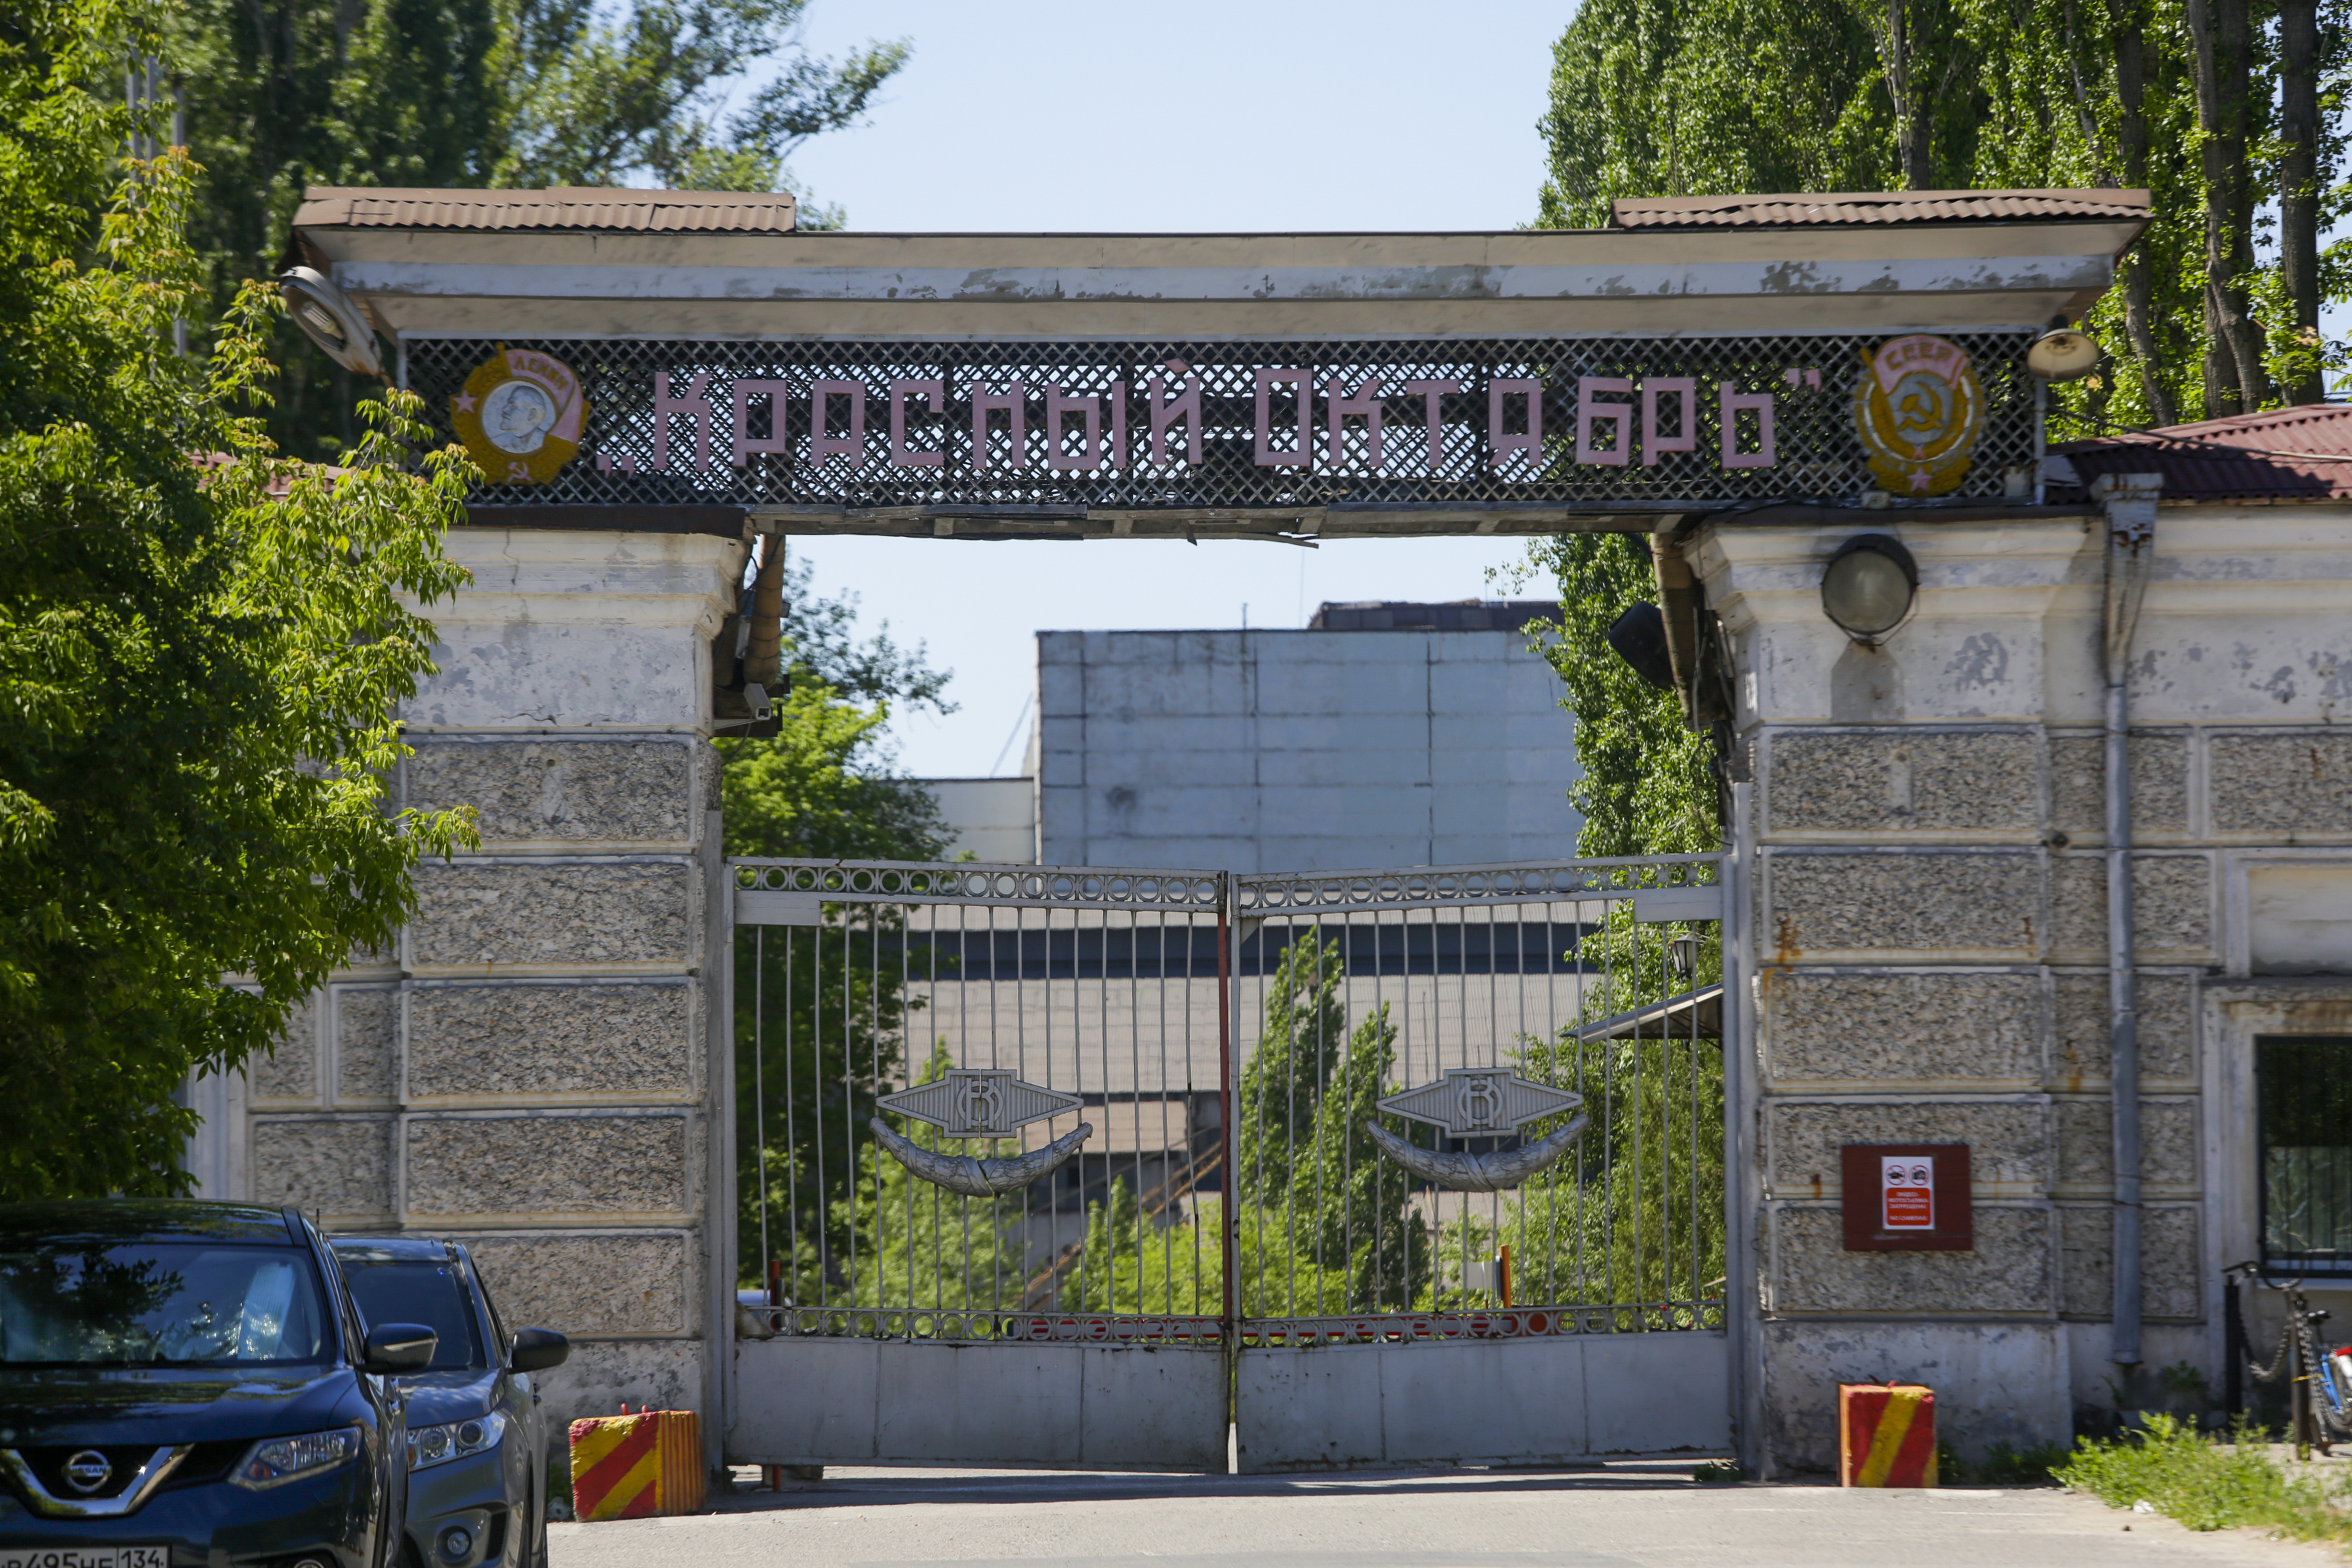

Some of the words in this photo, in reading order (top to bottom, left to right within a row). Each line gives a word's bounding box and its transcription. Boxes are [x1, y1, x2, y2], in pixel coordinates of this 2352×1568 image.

[1886, 342, 1954, 371] СССР
[513, 356, 569, 390] ЛЕНИН
[121, 1550, 160, 1568] 134
